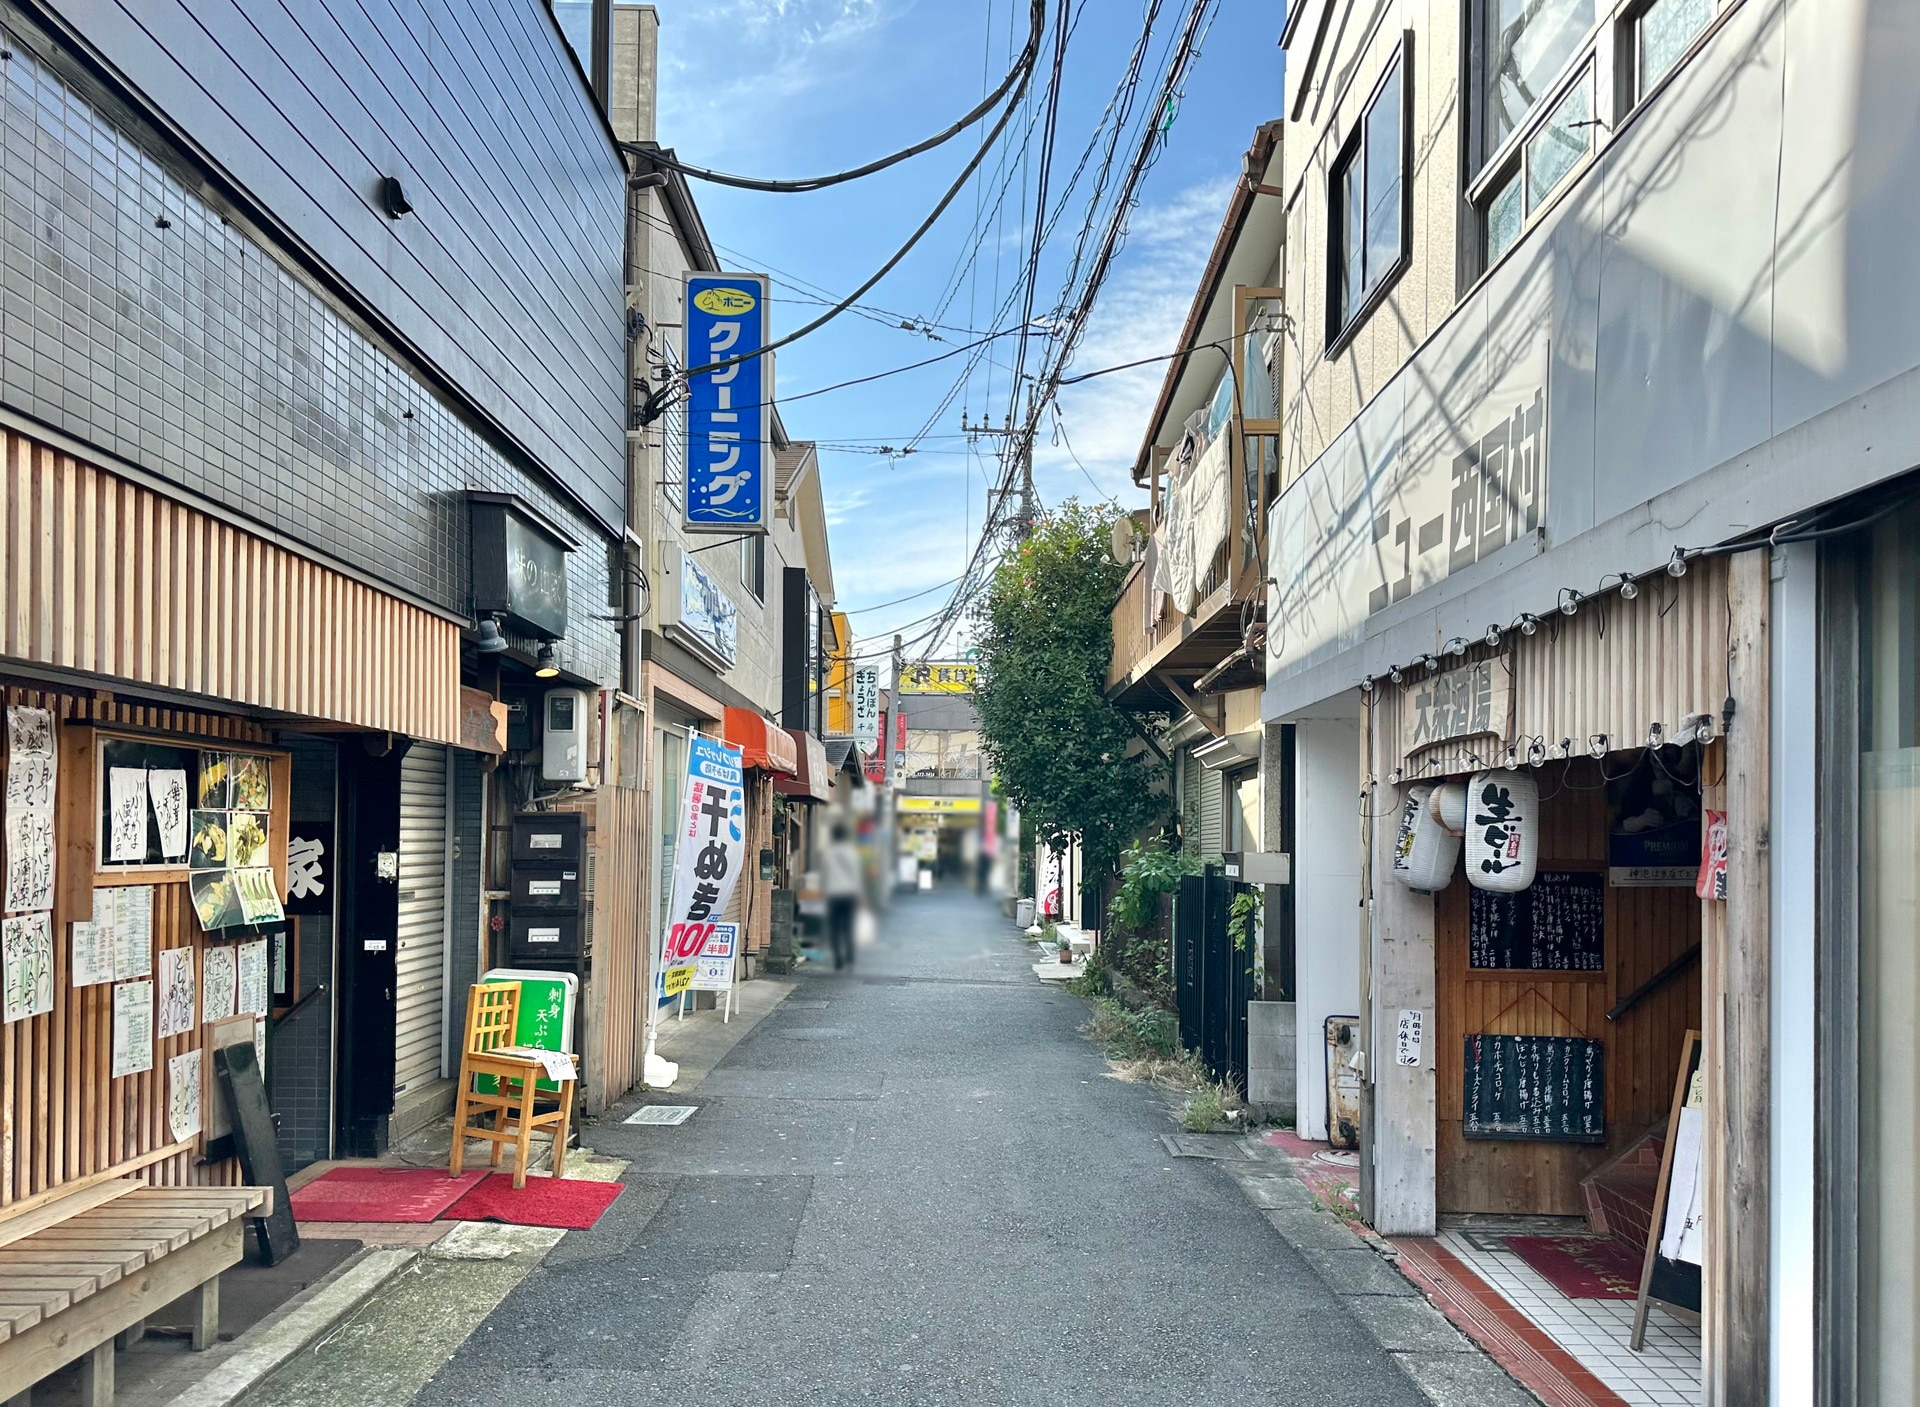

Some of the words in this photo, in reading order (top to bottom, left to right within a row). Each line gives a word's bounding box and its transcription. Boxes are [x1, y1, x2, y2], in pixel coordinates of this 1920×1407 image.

[722, 296, 752, 308] ポニー
[708, 321, 751, 505] クリーニング
[856, 669, 866, 718] ぎょうざ
[1475, 783, 1523, 874] 生ビール
[707, 944, 729, 954] 半額
[548, 987, 562, 1018] 刺身
